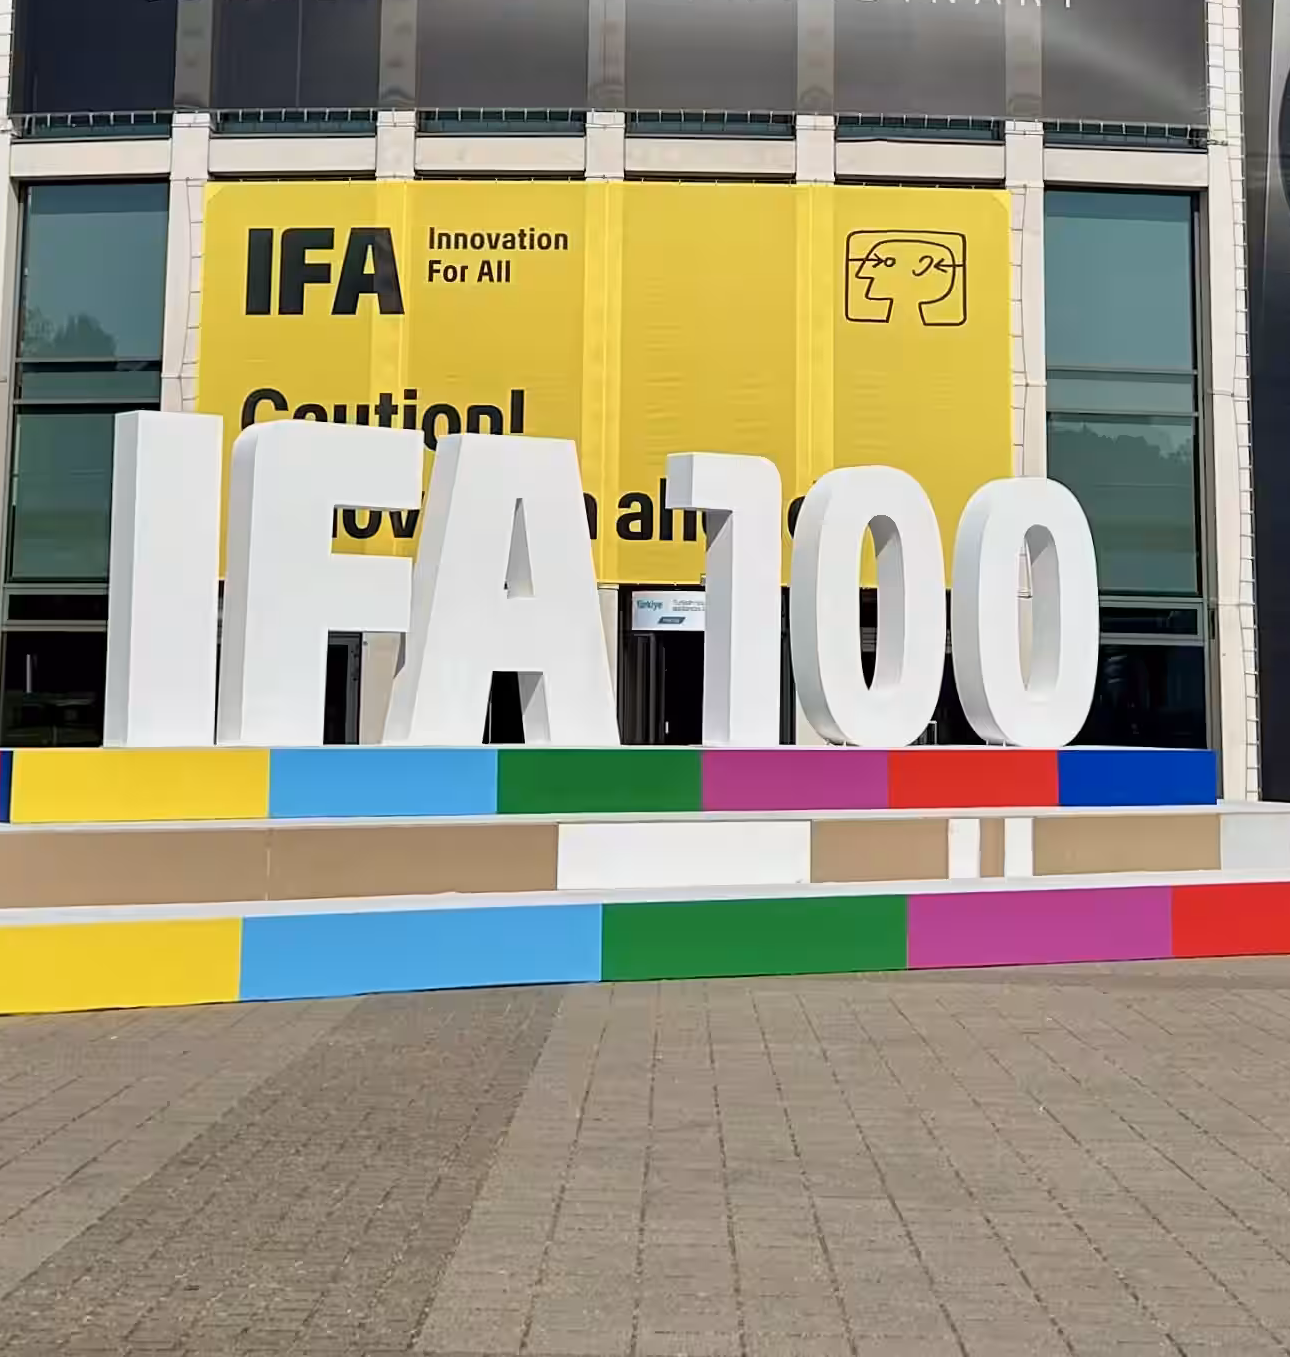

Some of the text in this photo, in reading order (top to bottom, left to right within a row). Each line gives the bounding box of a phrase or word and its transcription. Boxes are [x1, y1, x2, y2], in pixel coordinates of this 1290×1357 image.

[427, 226, 569, 251] Innovation
[245, 226, 406, 316] IFA
[427, 259, 512, 283] For All
[104, 410, 1100, 748] IFA 100
